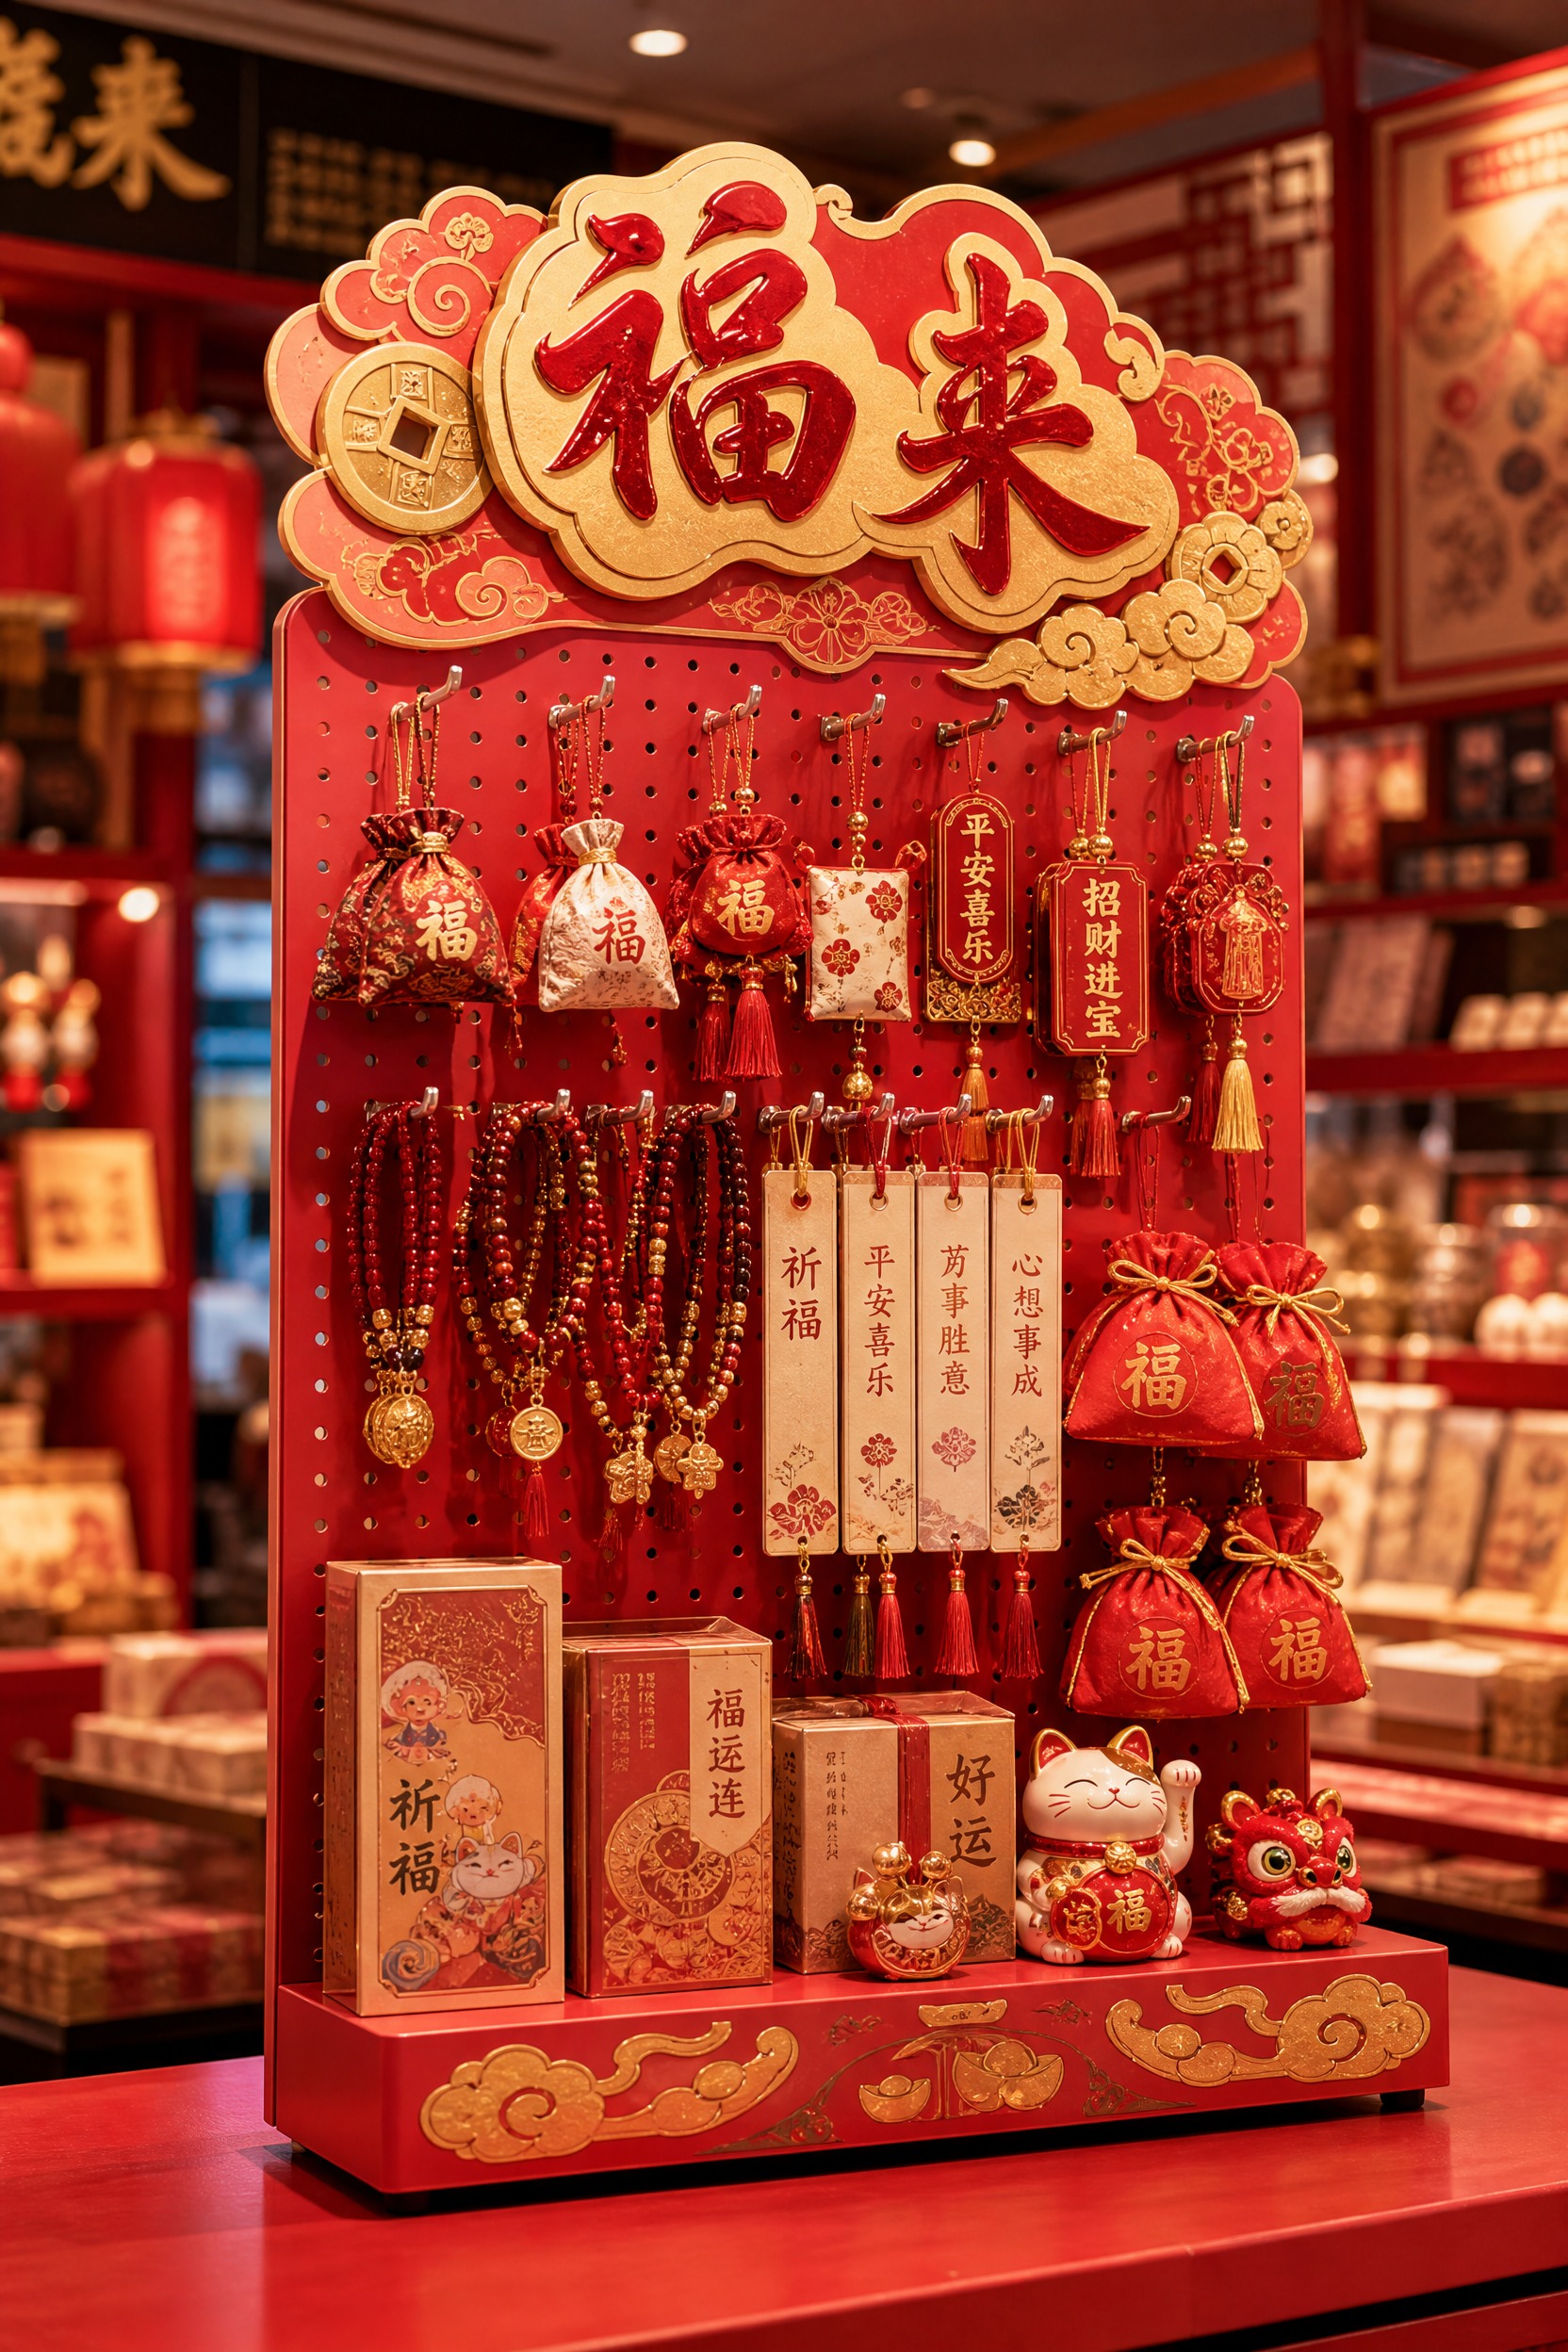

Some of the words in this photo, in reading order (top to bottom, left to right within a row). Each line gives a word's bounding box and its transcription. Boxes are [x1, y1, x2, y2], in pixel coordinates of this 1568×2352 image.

[536, 180, 1151, 596] 福来
[416, 900, 478, 962] 福
[593, 907, 645, 964] 福
[716, 879, 776, 936] 福
[960, 812, 996, 965] 平安喜乐
[1082, 878, 1123, 1038] 招财进宝
[781, 1246, 822, 1342] 祈福
[863, 1244, 895, 1397] 平安喜乐
[1011, 1252, 1043, 1397] 心想事成
[1120, 1342, 1186, 1411] 福
[1265, 1361, 1324, 1429] 福
[1126, 1625, 1191, 1690] 福
[1268, 1617, 1328, 1680] 福
[706, 1688, 745, 1819] 福运连
[388, 1779, 441, 1895] 祈福
[945, 1754, 997, 1868] 好运
[1106, 1887, 1152, 1934] 福
